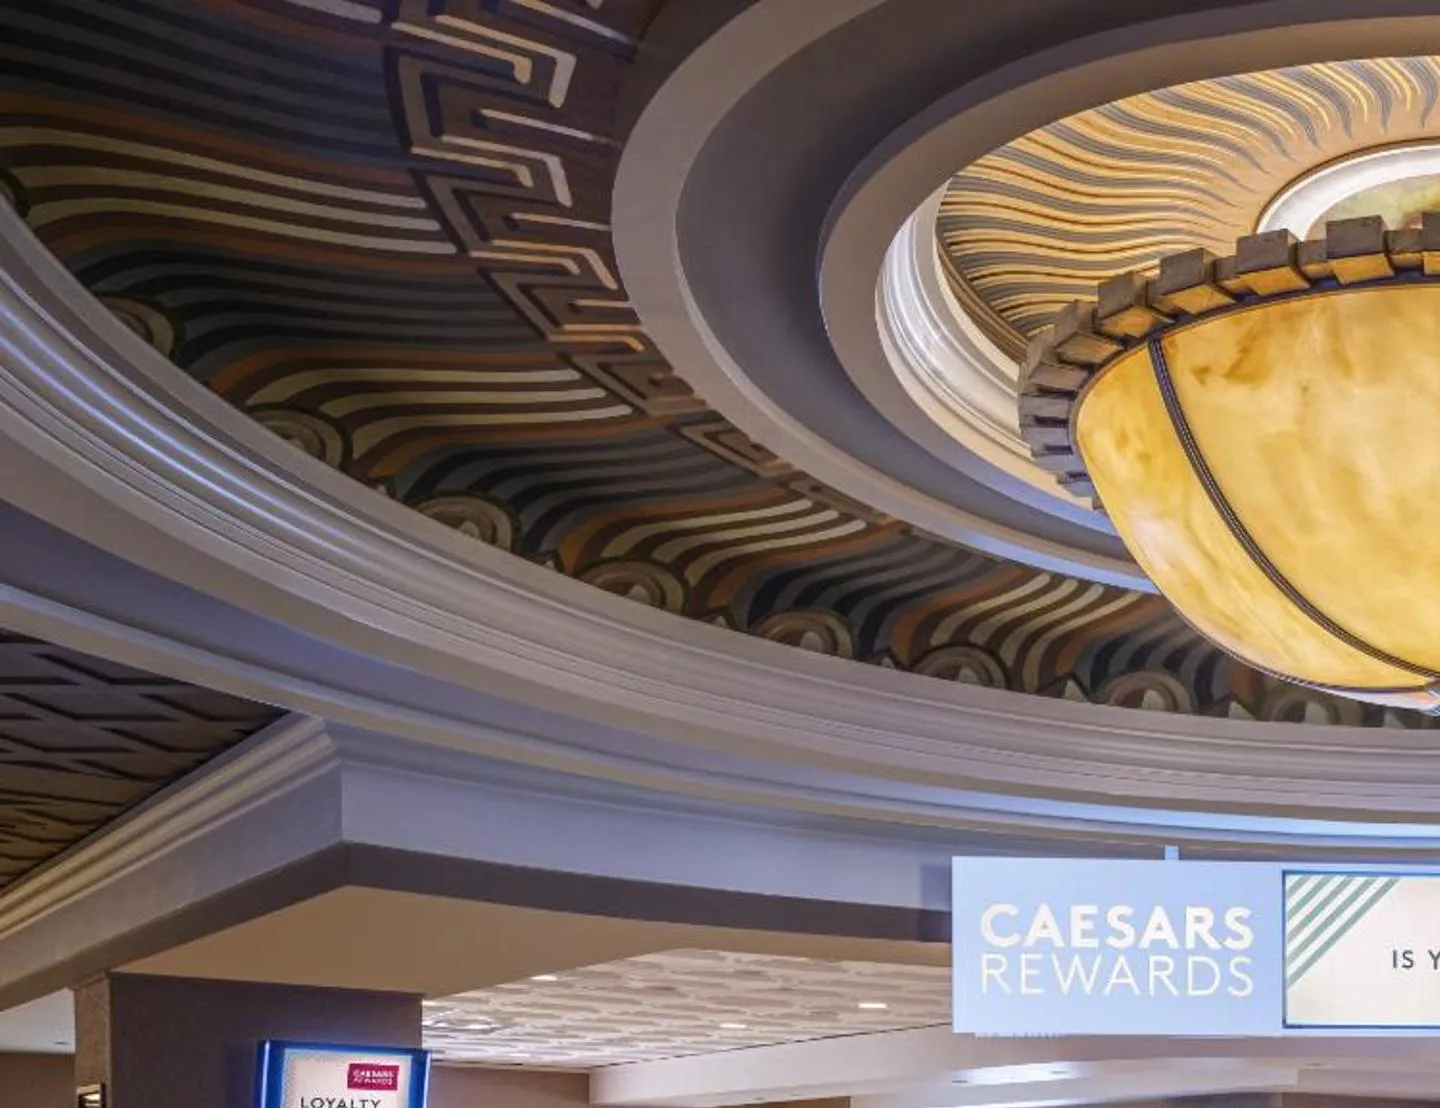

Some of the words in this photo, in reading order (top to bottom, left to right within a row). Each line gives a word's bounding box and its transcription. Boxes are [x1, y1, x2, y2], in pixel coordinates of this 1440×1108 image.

[980, 903, 1254, 950] CAESARS
[981, 953, 1254, 997] REWARDS
[1392, 949, 1415, 969] IS
